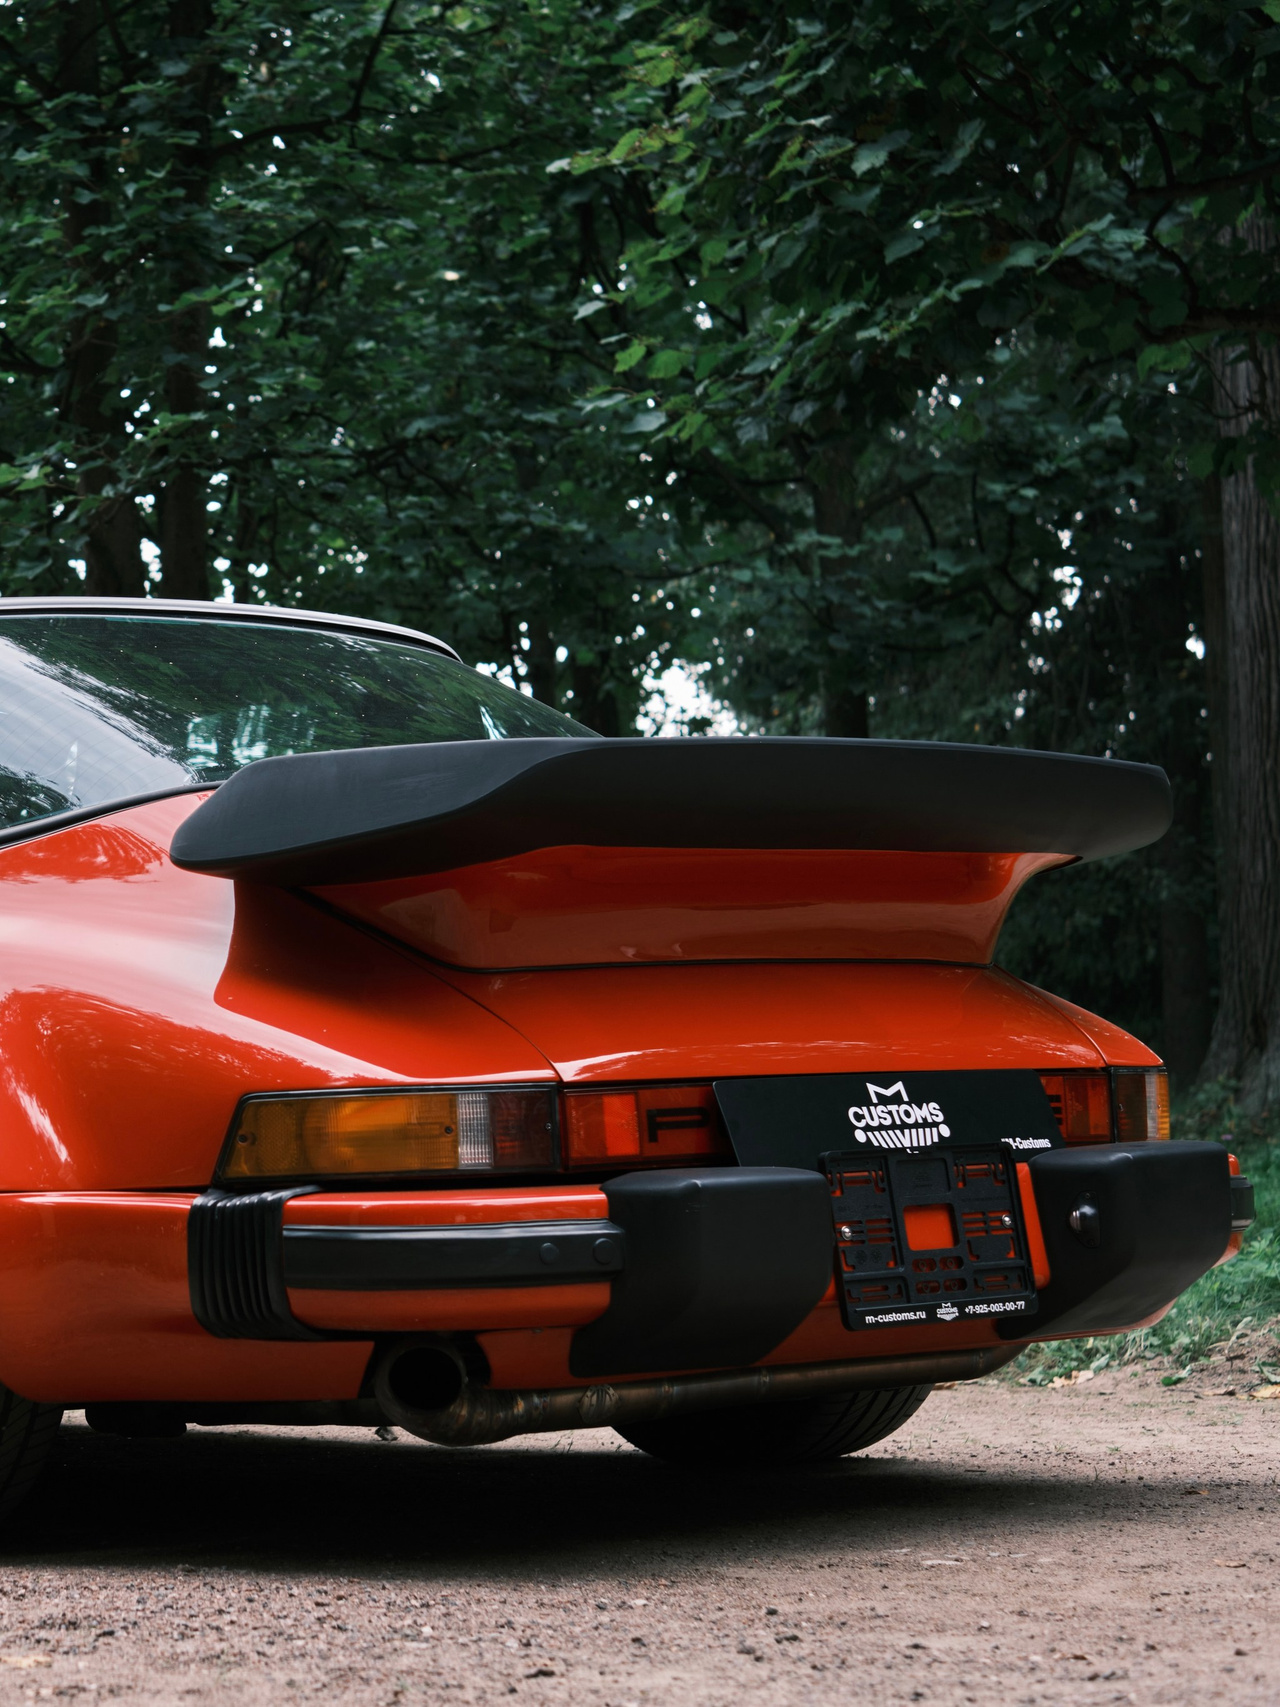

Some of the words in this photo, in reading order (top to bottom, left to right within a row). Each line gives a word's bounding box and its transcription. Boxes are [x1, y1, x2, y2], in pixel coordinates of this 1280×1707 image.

[865, 1080, 910, 1103] M
[847, 1101, 945, 1128] CUSTOMS
[964, 1301, 1026, 1314] +7-925-003-00-77
[865, 1310, 927, 1324] m-customs.ru
